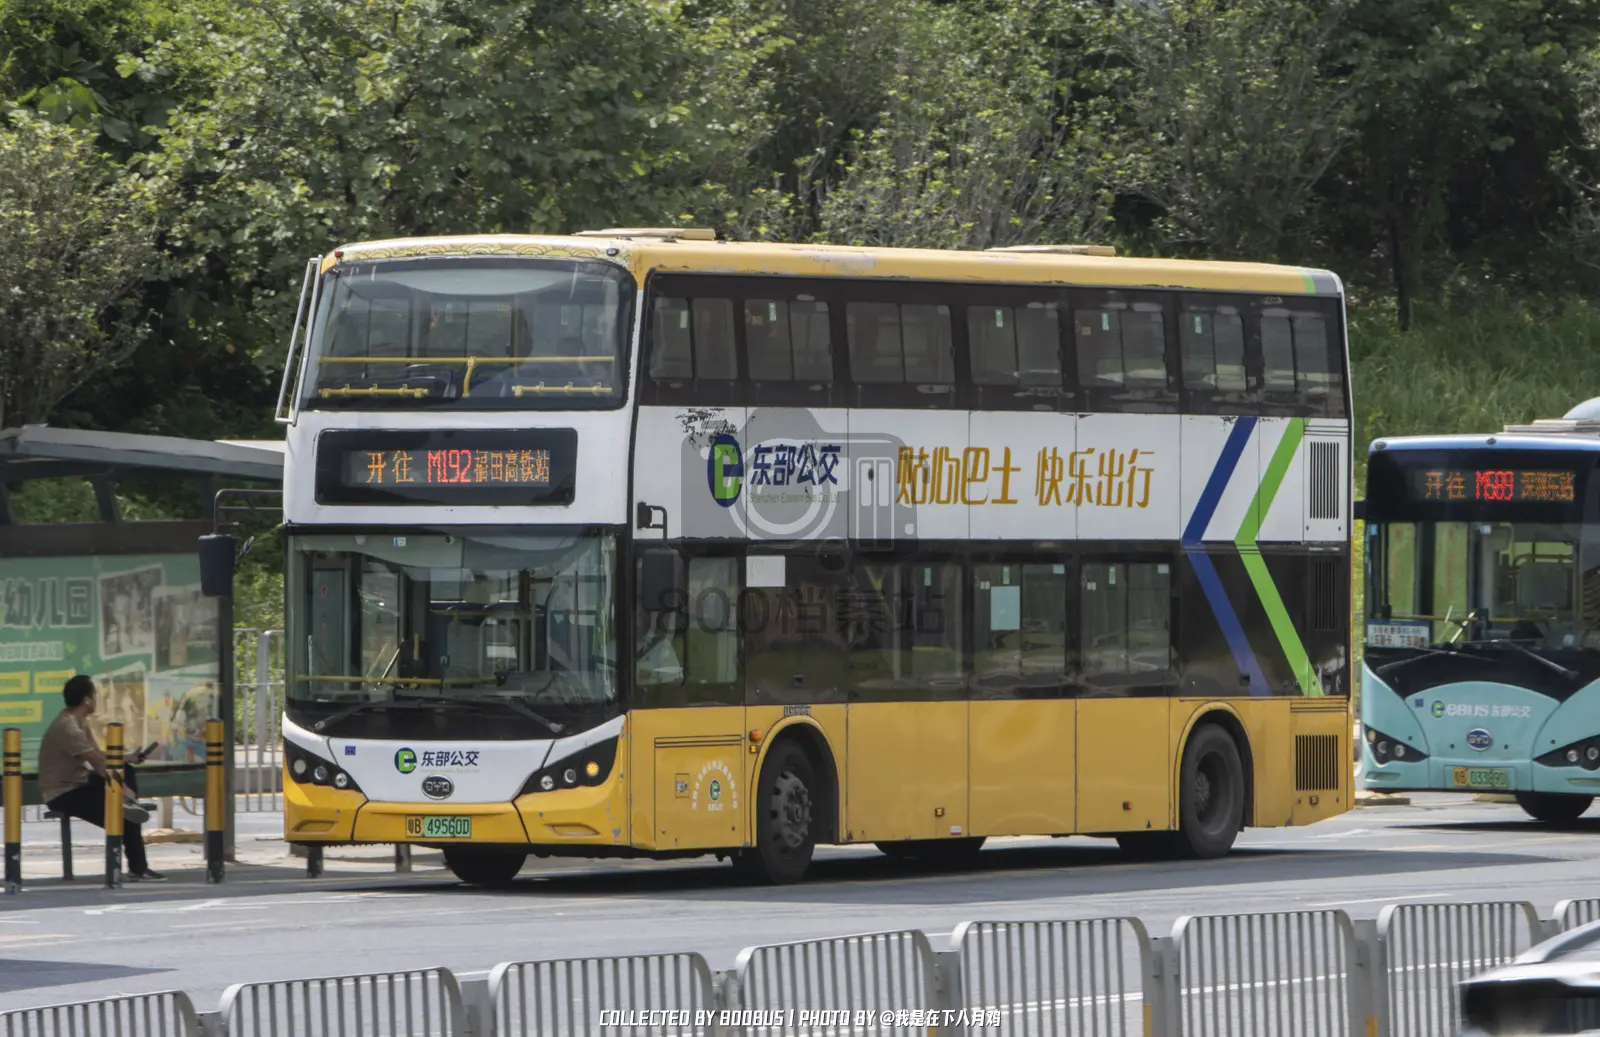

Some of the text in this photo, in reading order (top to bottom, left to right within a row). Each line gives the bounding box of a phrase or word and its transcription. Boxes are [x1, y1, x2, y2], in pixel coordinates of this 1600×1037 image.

[427, 449, 472, 483] M192
[474, 449, 551, 483] 福田高铁站
[750, 443, 842, 486] 东部公交
[895, 446, 1156, 508] 贴心巴士 快乐出行
[1468, 734, 1490, 745] BYD
[421, 750, 480, 767] 东部公交
[425, 780, 450, 793] BYD
